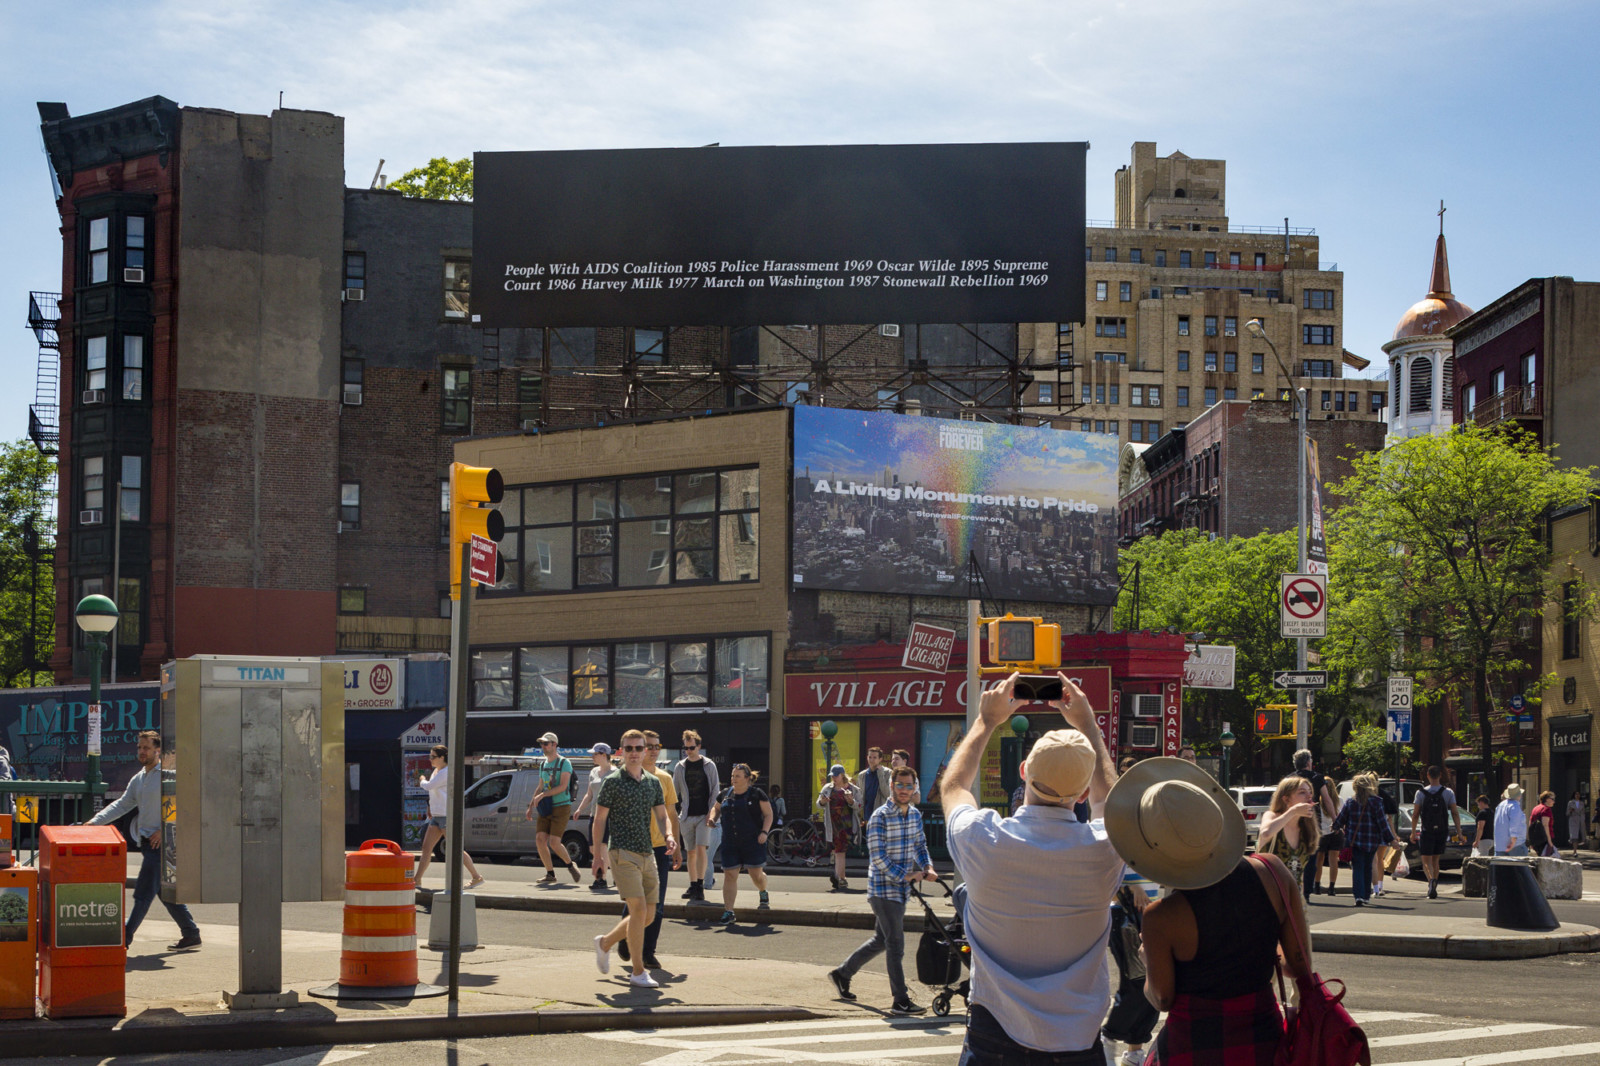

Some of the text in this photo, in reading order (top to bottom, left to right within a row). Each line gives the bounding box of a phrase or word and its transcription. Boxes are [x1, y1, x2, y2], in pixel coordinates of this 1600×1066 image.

[505, 259, 1049, 278] People With AIDS Coalition 1985 Police Harassment 1969 Oscar Wilde 1895 Supreme
[504, 274, 1049, 293] Court 1986 Harvey Milk 1977 March on Washington 1987 Stonewall Rebellion 1969
[939, 424, 984, 434] Stonewall
[939, 432, 984, 450] FOREVER
[814, 480, 1099, 514] A Living Monument to Pride
[916, 510, 1005, 524] StonewallForever.org
[914, 631, 952, 651] VILLAGE
[909, 646, 948, 669] CIGARS
[238, 667, 285, 680] TITAN
[376, 668, 387, 682] 24
[810, 680, 947, 708] VILLAGE
[1391, 694, 1409, 706] 20
[358, 699, 394, 708] GROCERY
[418, 723, 436, 732] ATM
[44, 734, 66, 748] Bag
[68, 734, 80, 745] &
[406, 736, 442, 744] FLOWERS
[1552, 731, 1588, 747] fat cat
[60, 901, 118, 918] metro
